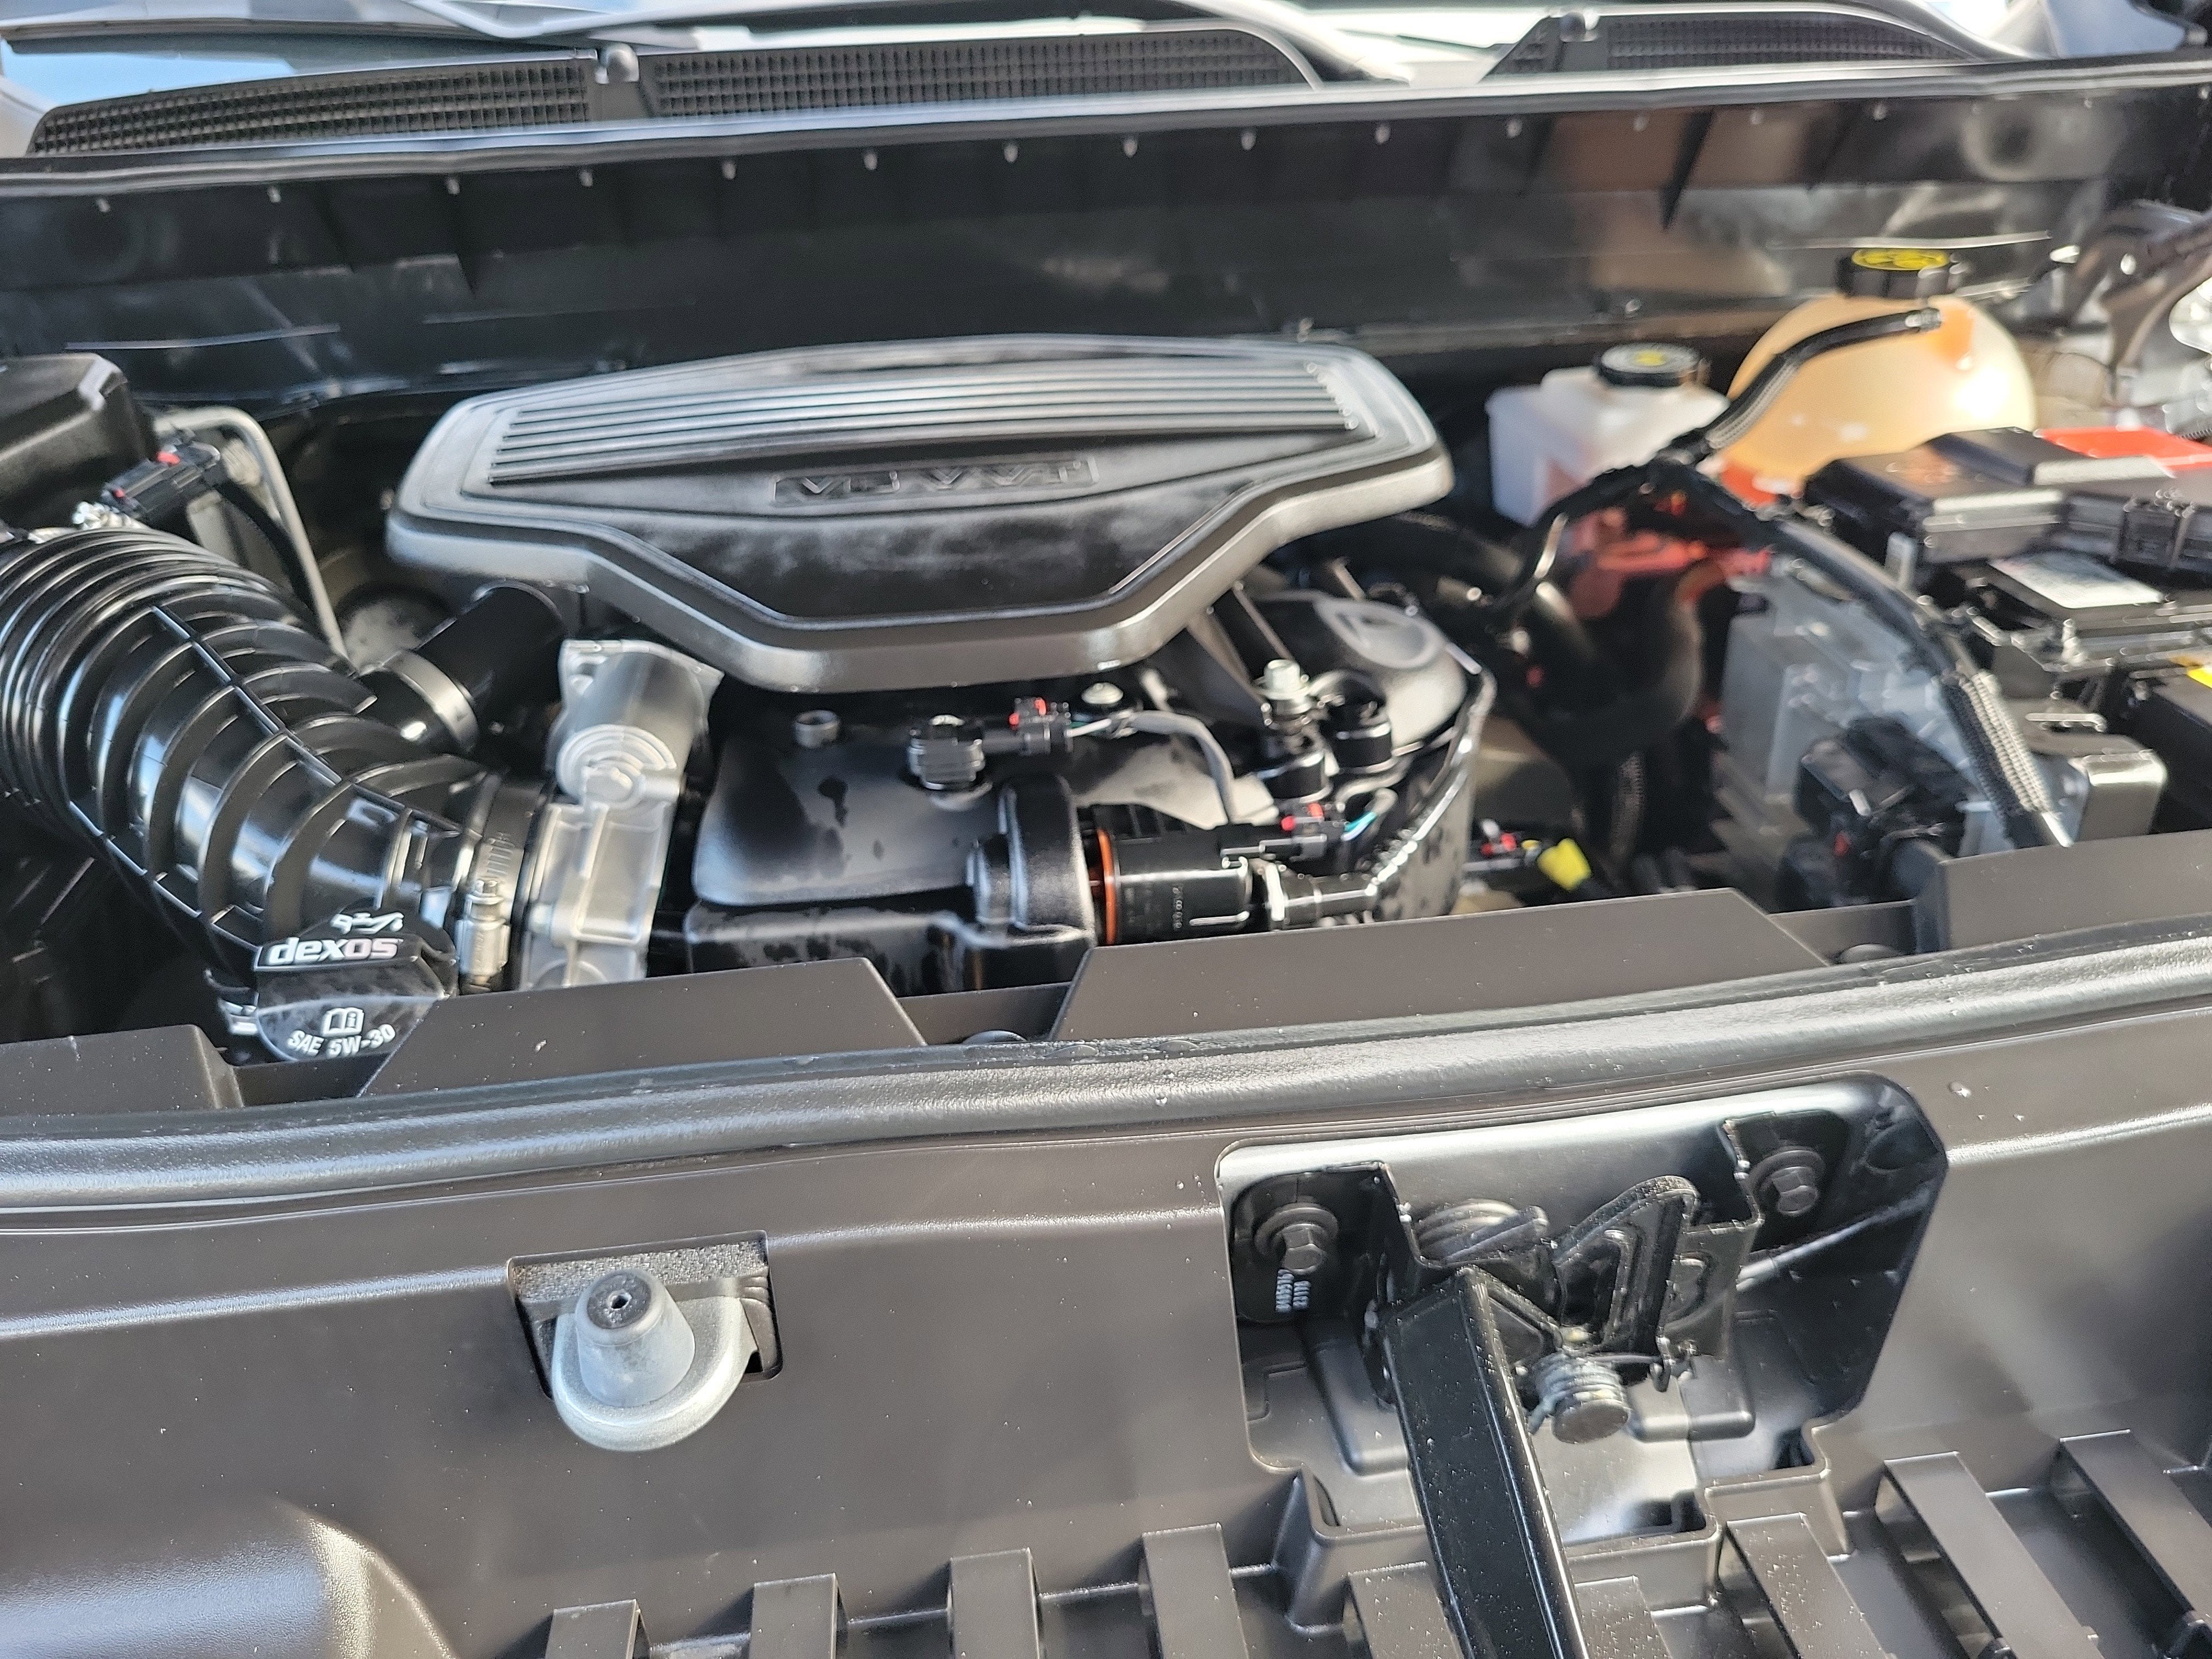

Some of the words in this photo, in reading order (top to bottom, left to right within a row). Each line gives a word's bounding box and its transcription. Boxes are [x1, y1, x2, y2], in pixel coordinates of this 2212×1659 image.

[266, 937, 398, 966] dexos
[287, 1030, 325, 1056] SAE
[327, 1024, 396, 1059] 5W-30
